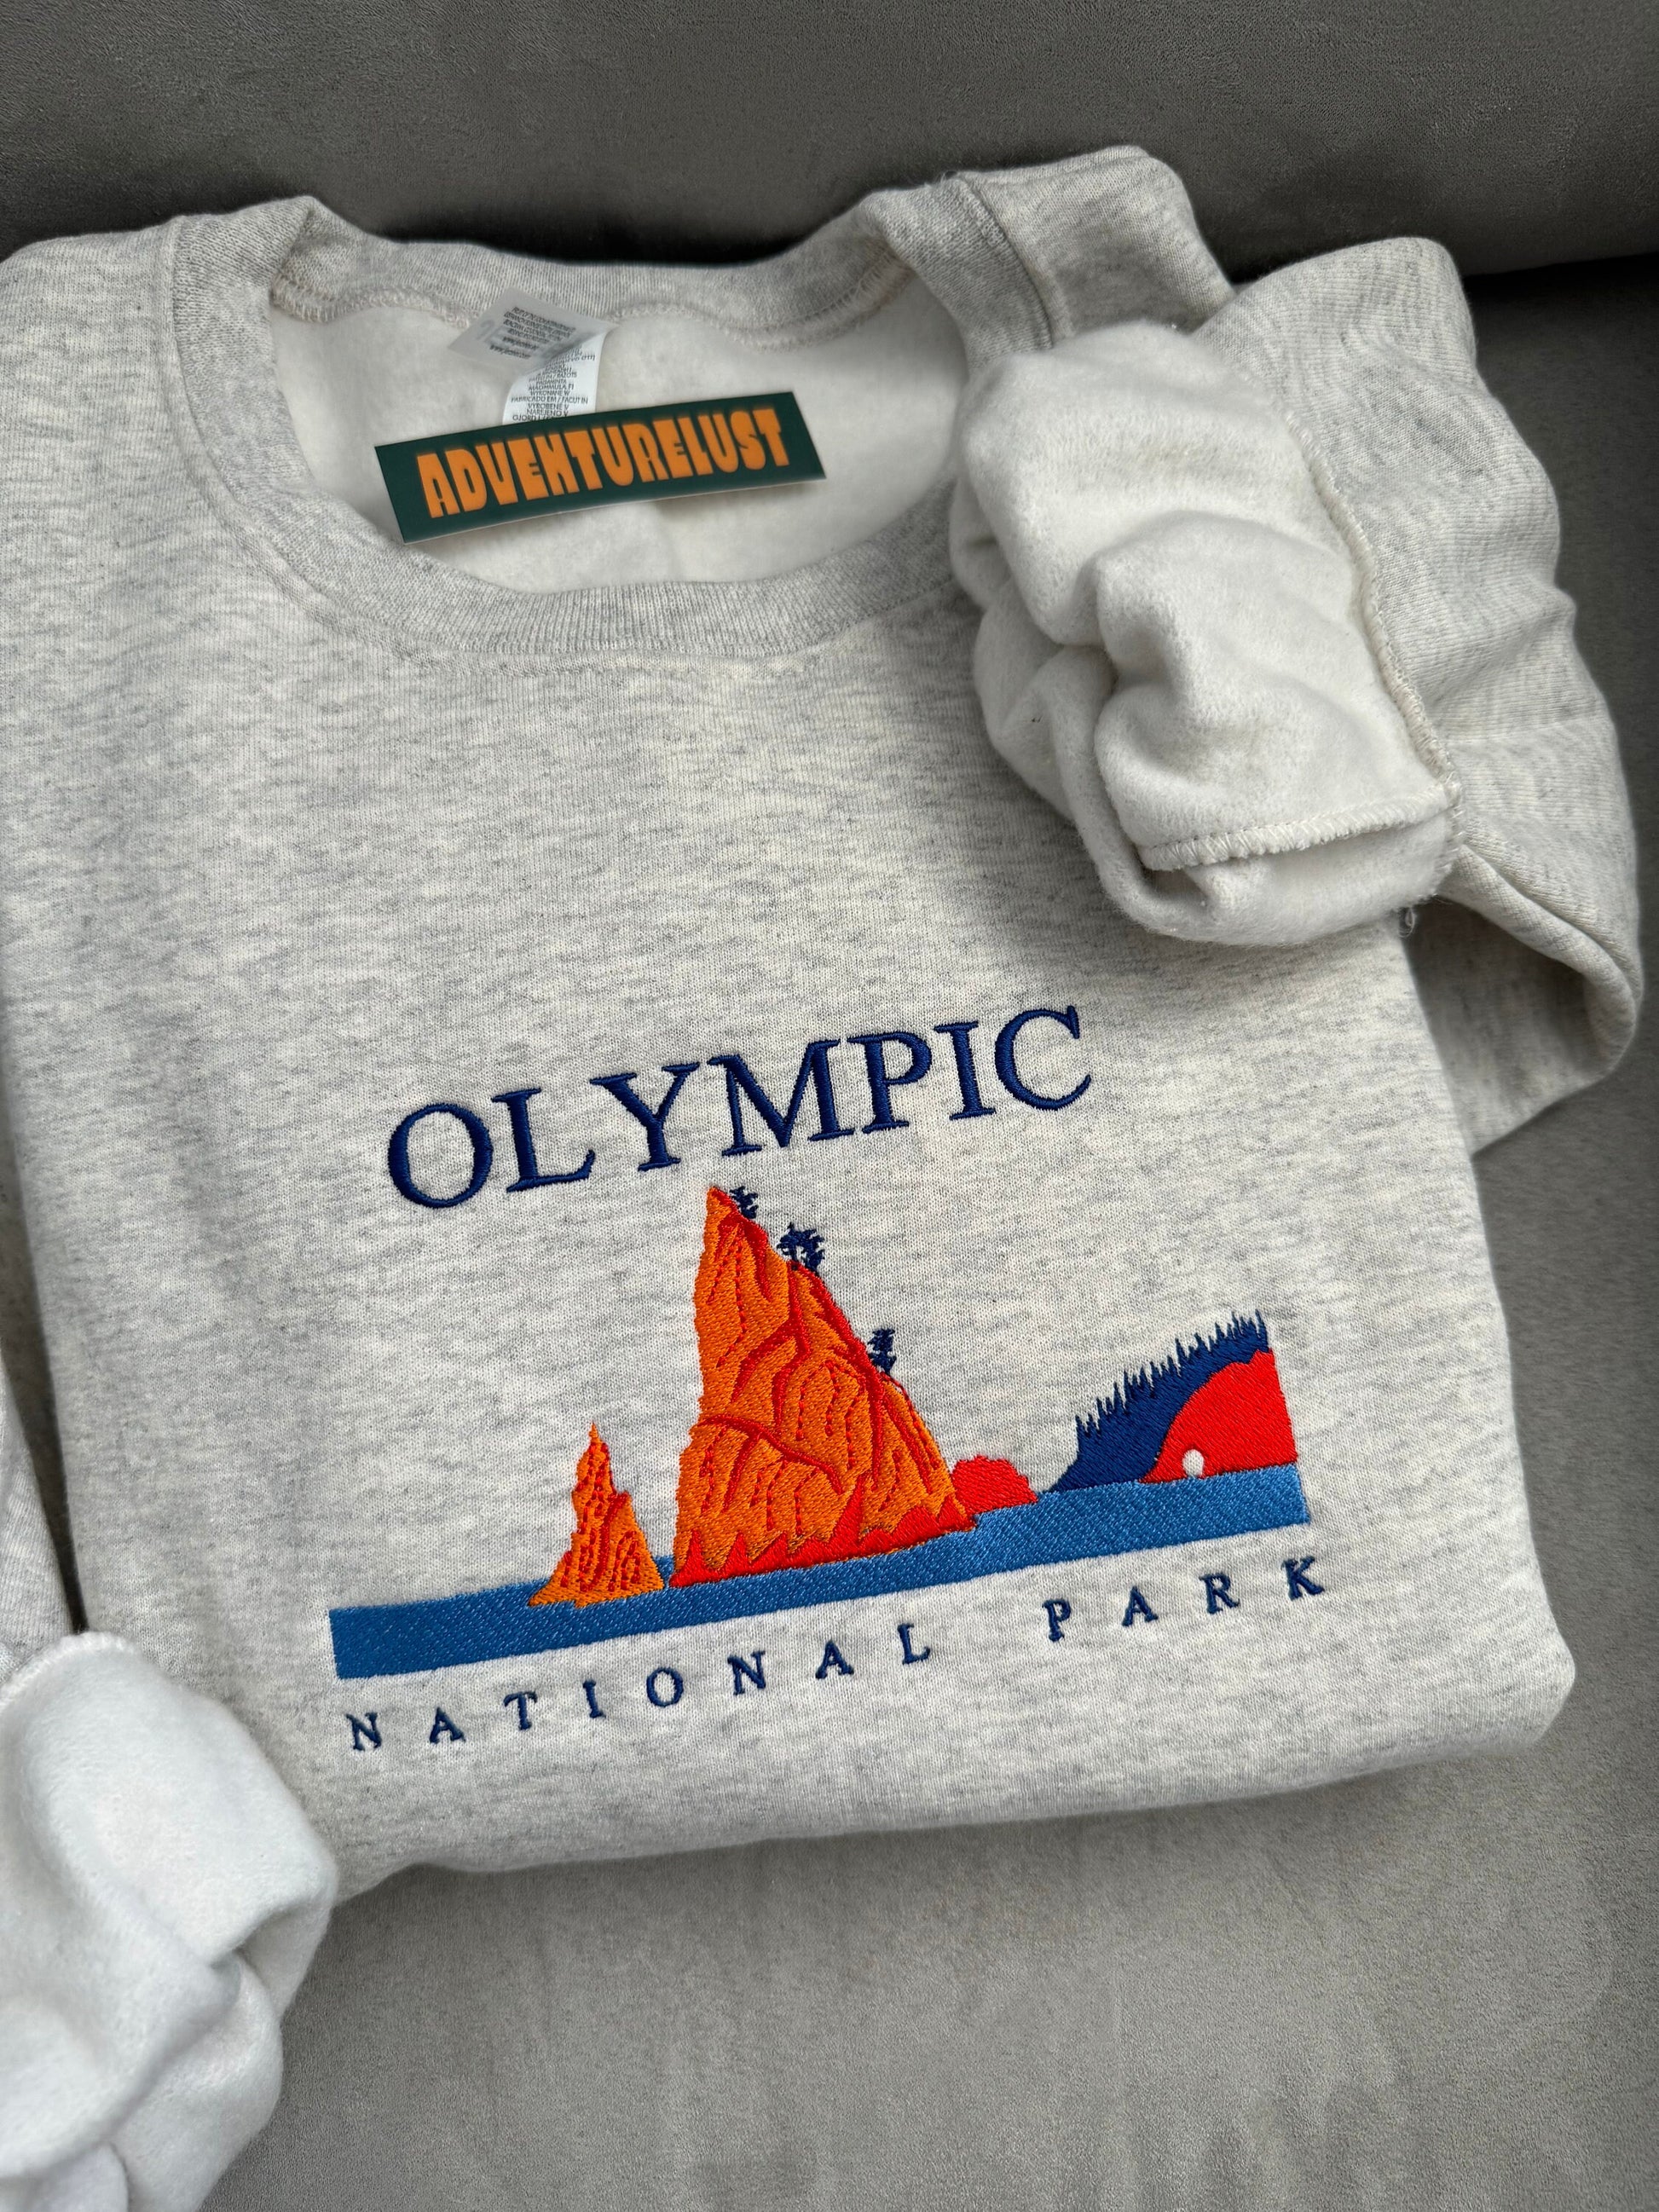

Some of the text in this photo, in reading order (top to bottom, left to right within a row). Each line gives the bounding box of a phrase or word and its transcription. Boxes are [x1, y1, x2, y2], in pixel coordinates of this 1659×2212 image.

[416, 407, 789, 519] ADVENTURELUST
[387, 1005, 1092, 1210] OLYMPIC
[346, 1556, 1325, 1752] NATIONAL PARK
